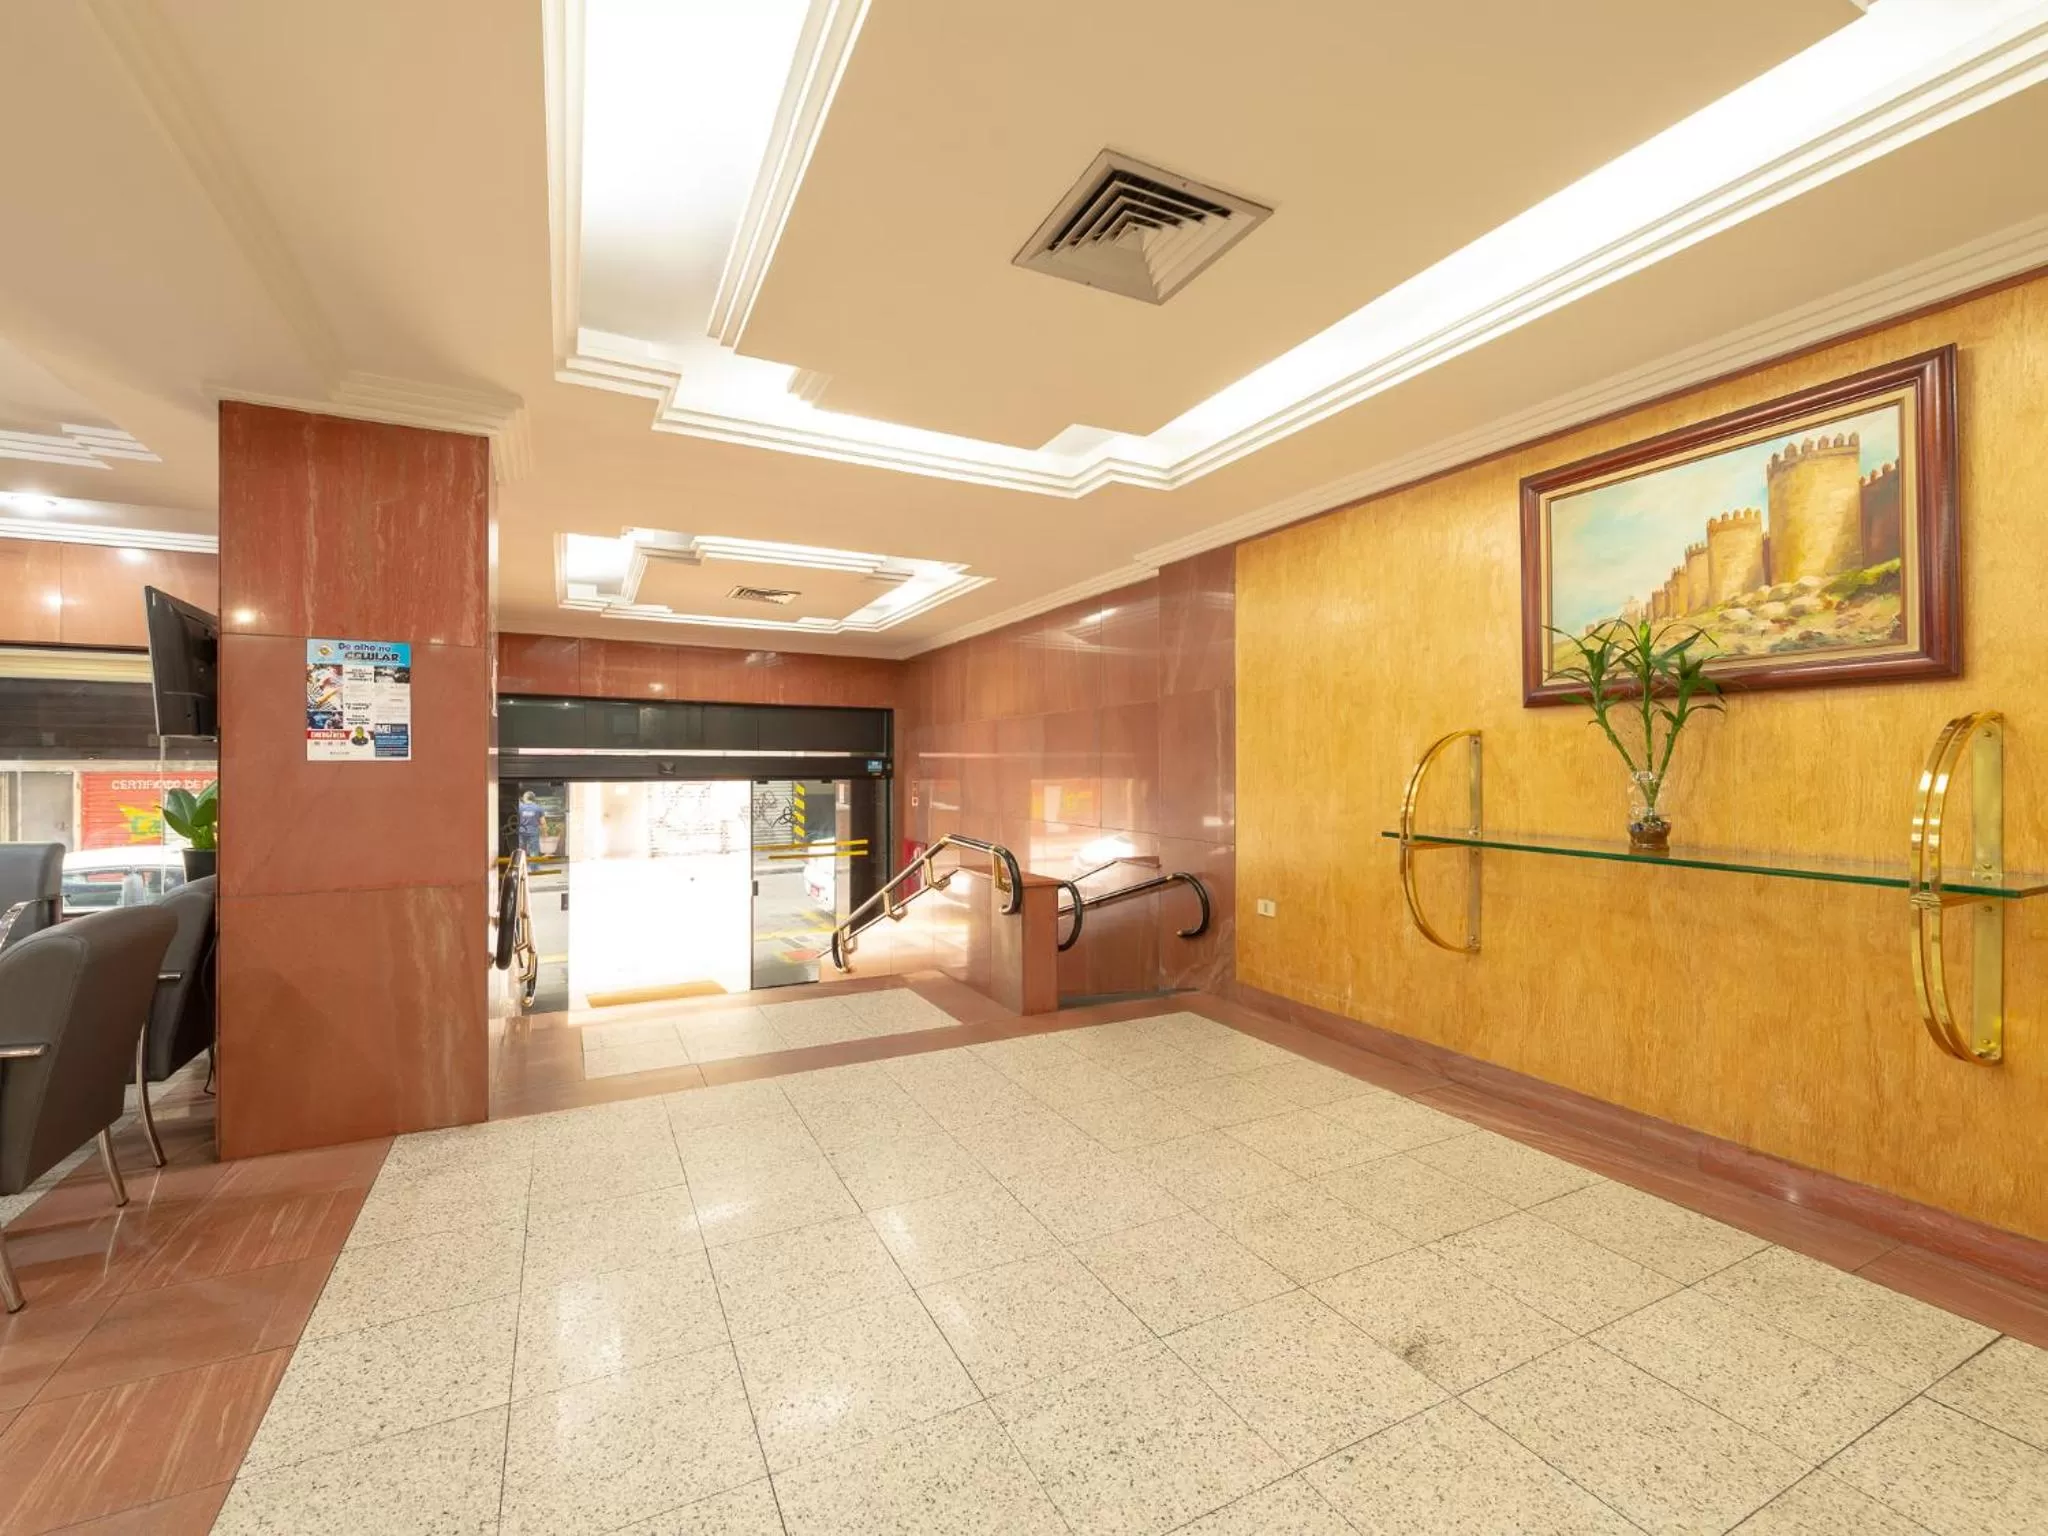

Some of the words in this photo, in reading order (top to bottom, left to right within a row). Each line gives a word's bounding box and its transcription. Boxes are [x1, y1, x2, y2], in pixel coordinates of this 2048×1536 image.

[338, 642, 351, 651] De
[354, 643, 376, 651] olho
[344, 651, 400, 661] CELULAR
[111, 779, 181, 790] CERTIFICADO
[184, 779, 201, 789] DE
